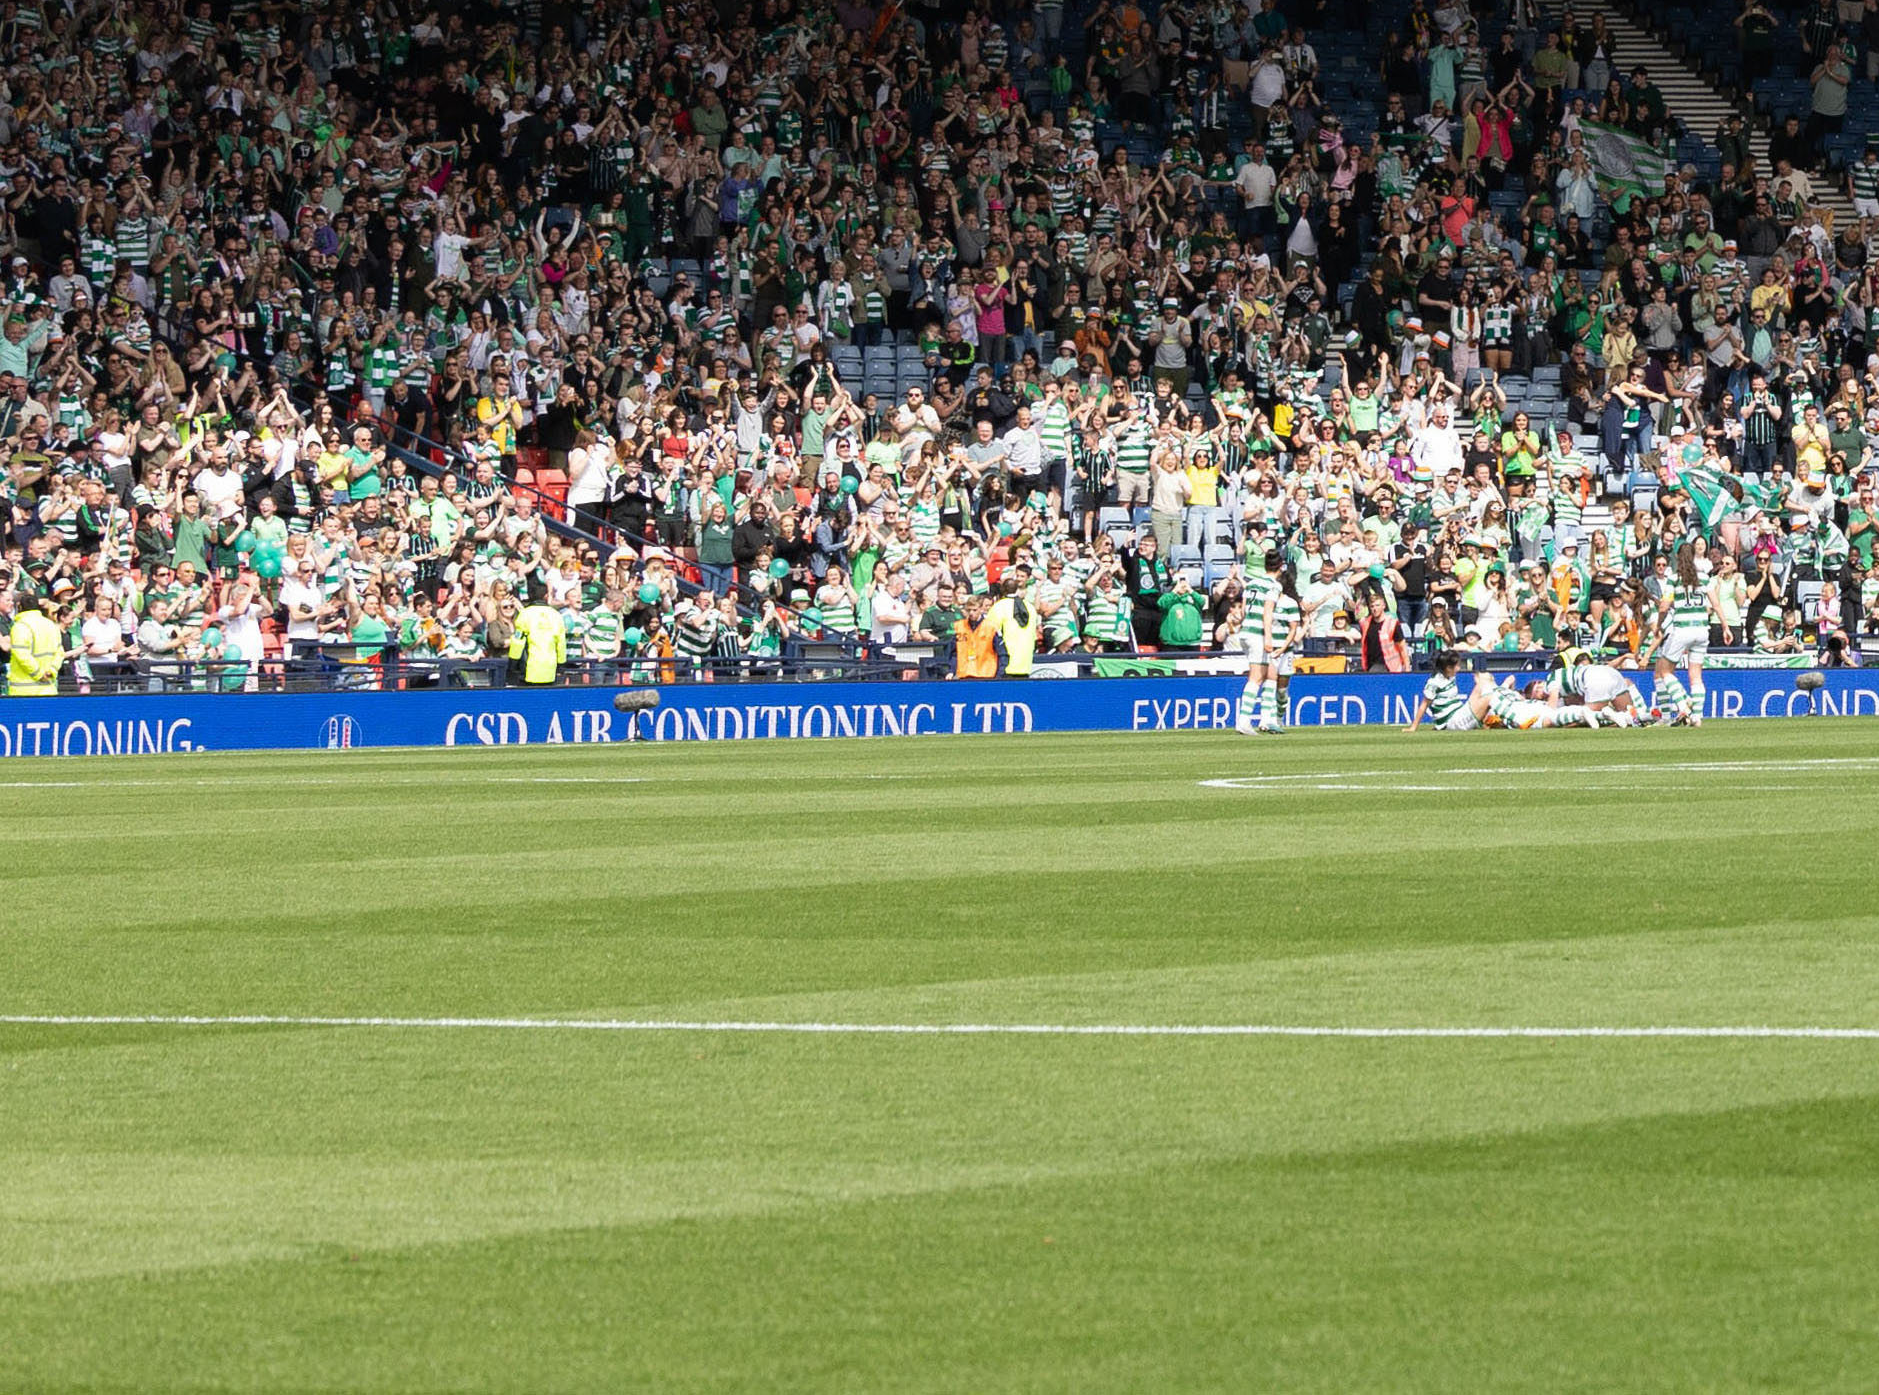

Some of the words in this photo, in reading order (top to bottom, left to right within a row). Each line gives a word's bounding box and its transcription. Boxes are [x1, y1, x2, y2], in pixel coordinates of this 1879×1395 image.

[1248, 589, 1258, 612] 7
[1684, 586, 1705, 608] 15
[445, 711, 529, 747] CSD
[546, 709, 612, 744] AIR
[627, 702, 937, 742] CONDITIONING
[950, 701, 1034, 735] LTD
